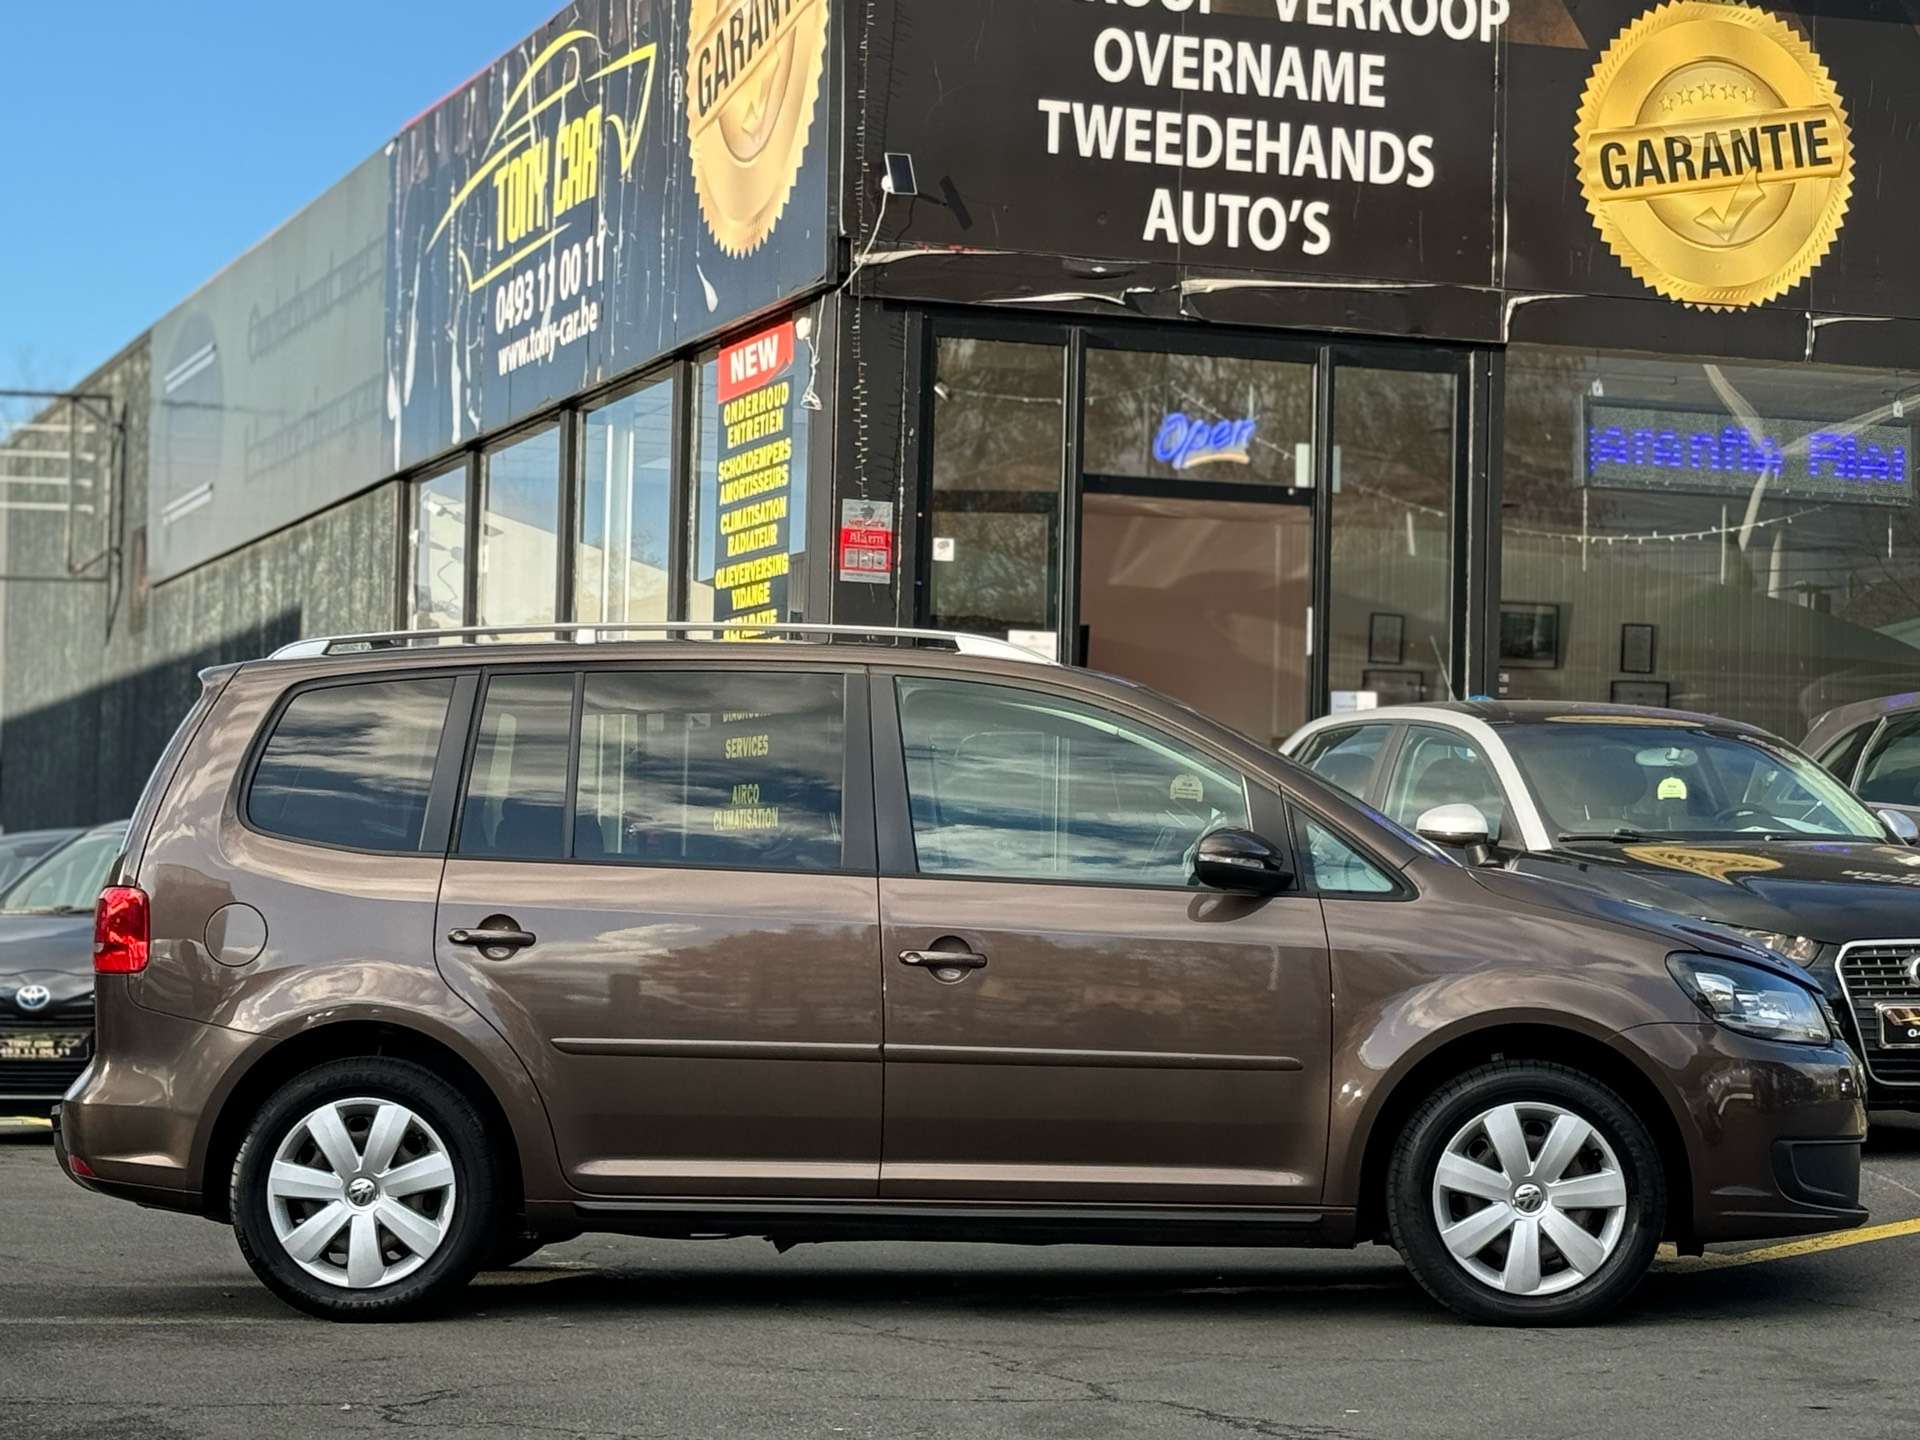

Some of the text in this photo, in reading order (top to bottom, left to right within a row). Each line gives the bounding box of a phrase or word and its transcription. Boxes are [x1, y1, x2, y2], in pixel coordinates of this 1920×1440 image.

[698, 0, 792, 118] GARAN
[1094, 28, 1386, 108] OVERNAME
[553, 104, 602, 217] CAR
[1038, 98, 1434, 188] TWEEDEHANDS
[1601, 119, 1833, 191] GARANTIE
[1142, 188, 1332, 256] AUTO'S
[496, 270, 534, 334] 0493
[560, 243, 581, 300] 00
[498, 295, 597, 376] www.tony-car.be
[731, 333, 778, 385] NEW
[723, 381, 789, 427] ONDERHOUD
[727, 407, 784, 449] ENTRETIEN
[1153, 412, 1256, 470] Open
[718, 437, 791, 483] SCHOKDEMPERS
[719, 464, 788, 506] AMORTISSEURS
[721, 495, 787, 535] CLIMATISATION
[727, 523, 777, 557] RADIATEUR
[715, 552, 789, 590] OLIEVERVERSING
[732, 581, 770, 611] VIDANGE
[725, 734, 768, 760] SERVICES
[732, 783, 759, 806] AIRCO
[713, 806, 778, 832] CLIMATISATION
